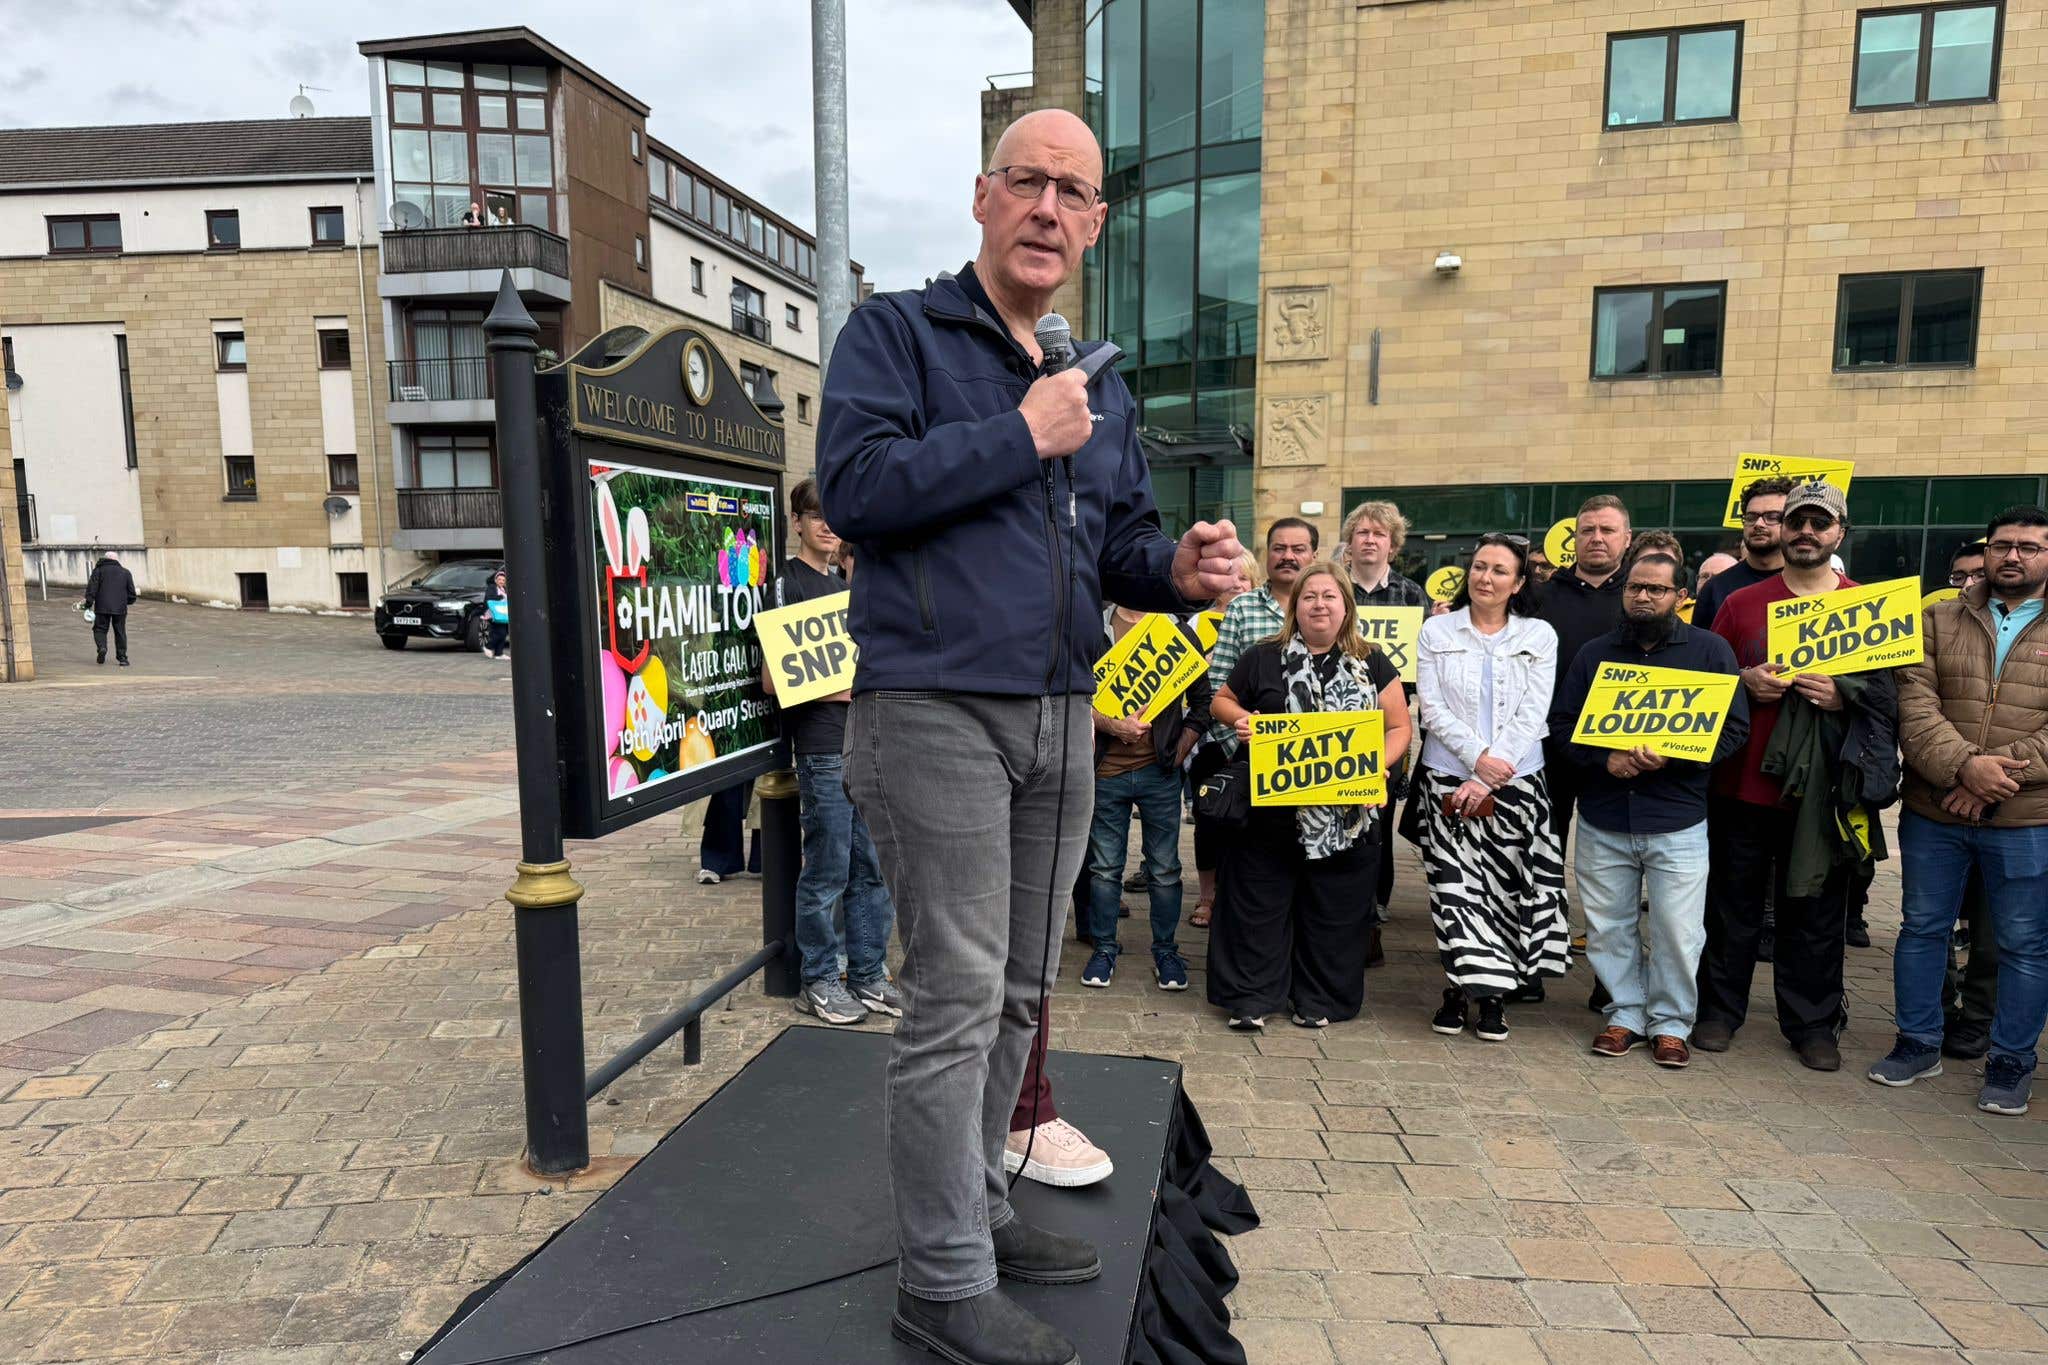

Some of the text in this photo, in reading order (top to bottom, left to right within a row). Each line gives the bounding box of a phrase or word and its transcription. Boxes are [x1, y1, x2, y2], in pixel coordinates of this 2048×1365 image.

[583, 383, 781, 458] WELCOME TO HAMILTON
[1742, 458, 1771, 471] SNP
[1560, 553, 1577, 563] SN
[1435, 588, 1455, 598] SNP
[1775, 601, 1811, 619] SNP
[1798, 596, 1888, 644] KATY
[781, 641, 847, 687] SNP
[1110, 632, 1157, 702] KATY
[1866, 649, 1915, 663] #VoteSNP
[1114, 635, 1188, 719] OUDON
[1173, 661, 1200, 689] #VoteSNP
[1602, 668, 1637, 682] SNP
[1612, 688, 1704, 710] KATY
[617, 724, 650, 755] 19th
[655, 714, 686, 750] April
[697, 706, 738, 736] Quarry
[740, 698, 774, 722] Street
[1255, 720, 1287, 734] SNP
[1581, 711, 1719, 734] LOUDON
[1277, 728, 1355, 766] KATY
[1661, 741, 1707, 754] #VoteSNP
[1257, 750, 1378, 796] LOUDON
[1337, 789, 1379, 797] #VoteSNP
